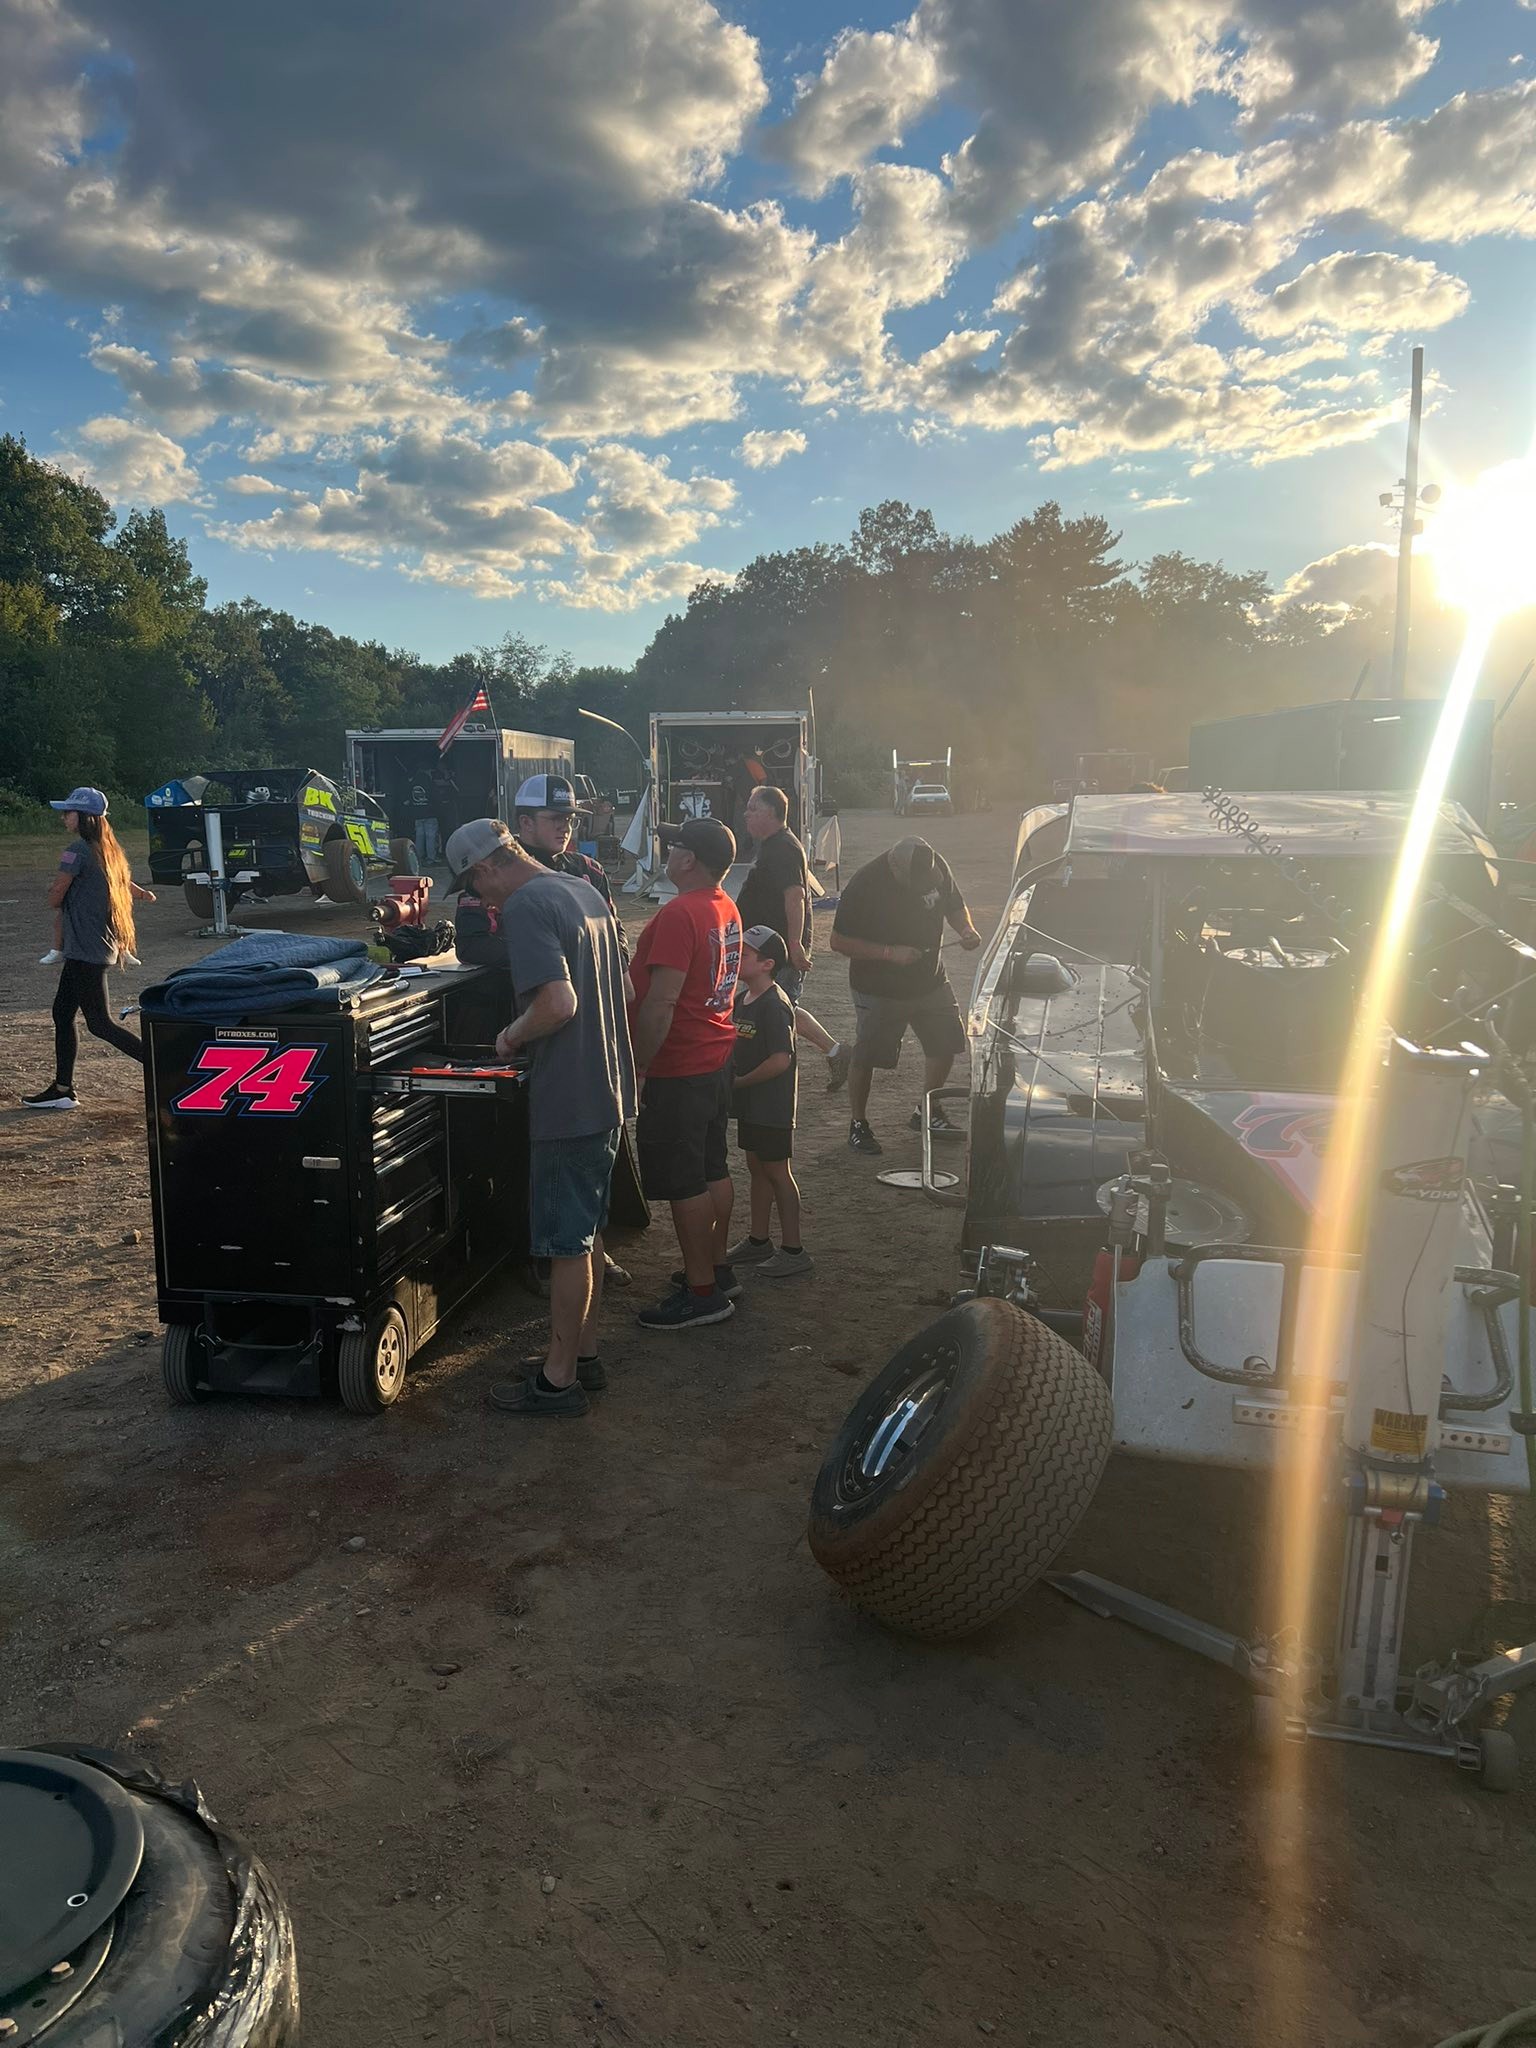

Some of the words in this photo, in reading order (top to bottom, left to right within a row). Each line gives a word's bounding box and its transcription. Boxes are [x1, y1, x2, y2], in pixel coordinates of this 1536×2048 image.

[303, 786, 337, 814] BK
[345, 822, 376, 856] 51
[217, 1029, 277, 1039] PITBOXES.COM
[175, 1045, 321, 1113] 74
